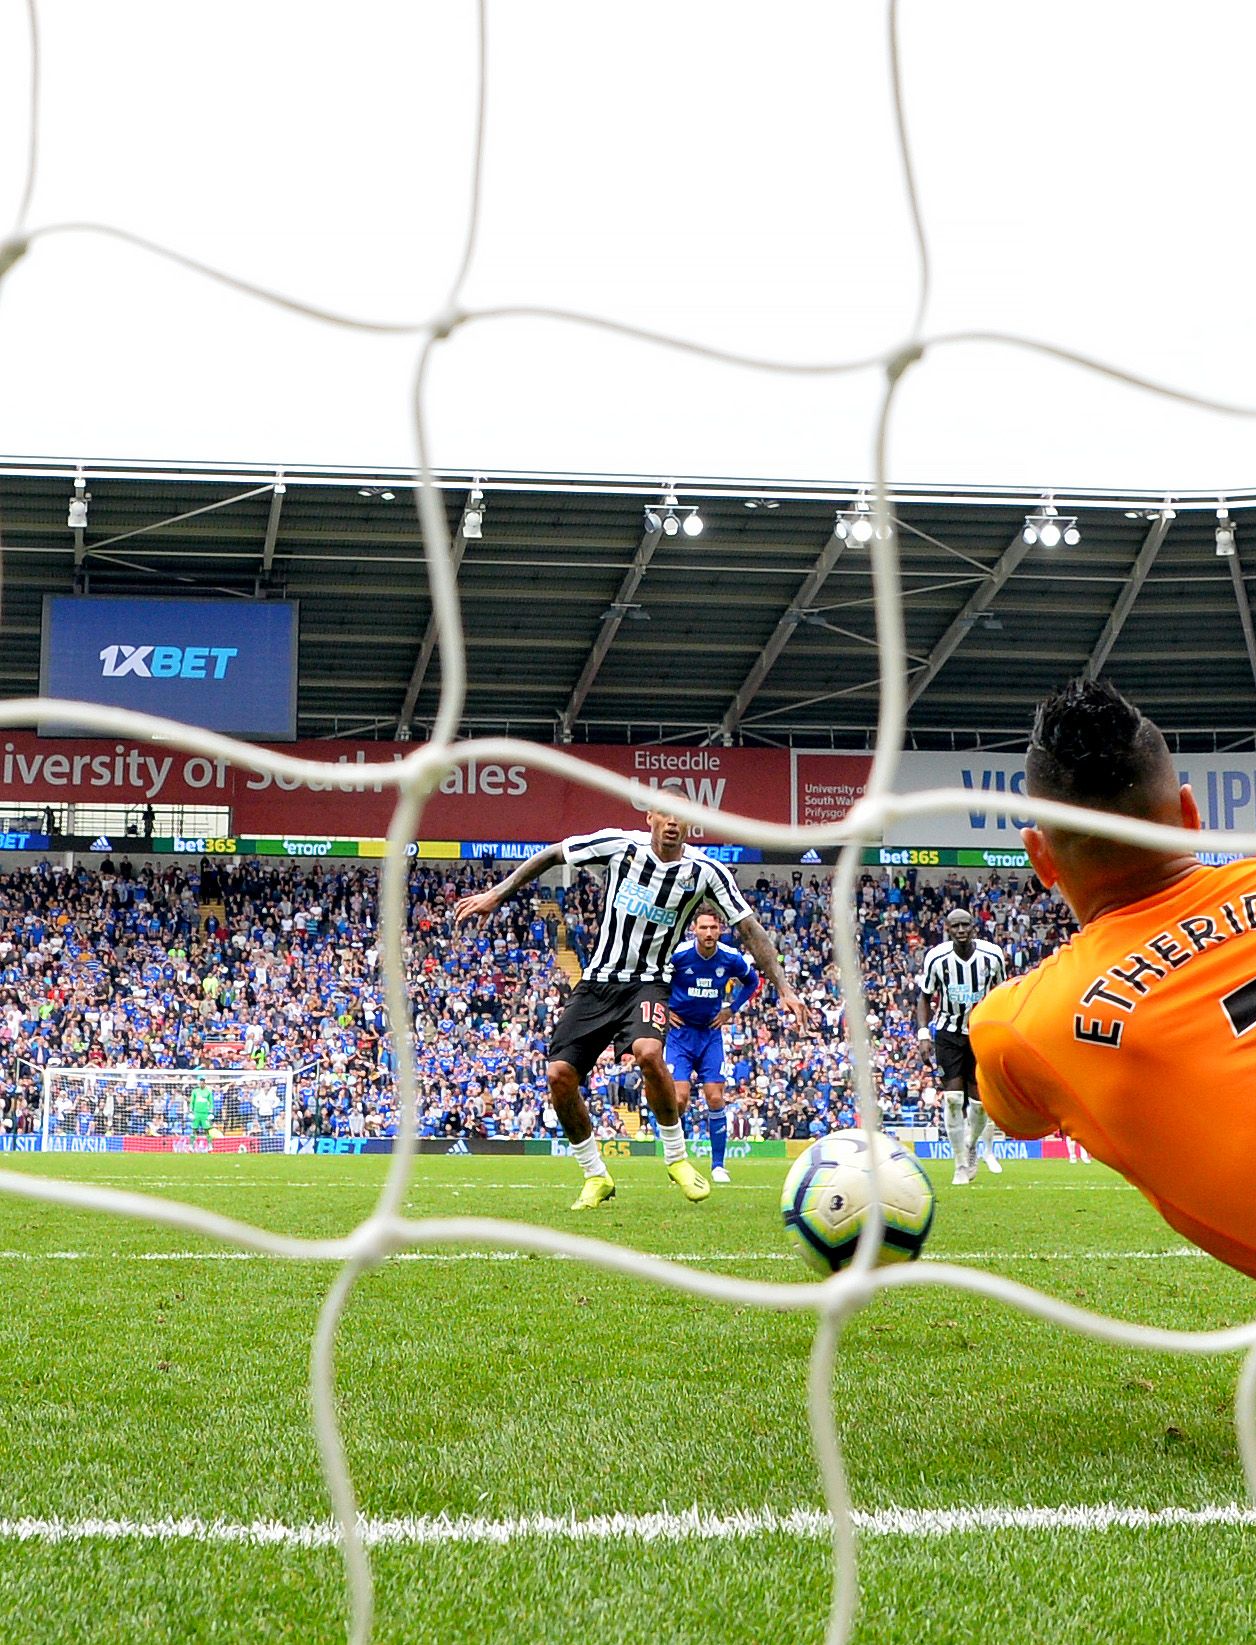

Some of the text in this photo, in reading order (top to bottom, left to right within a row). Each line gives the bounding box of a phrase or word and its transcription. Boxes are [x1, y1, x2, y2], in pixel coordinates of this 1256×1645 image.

[100, 645, 238, 679] 1XBET
[634, 751, 720, 771] Eisteddle
[630, 776, 727, 812] UW
[805, 784, 854, 795] University
[805, 796, 855, 806] South Wal
[805, 807, 846, 820] Prifysgol
[173, 837, 237, 852] bet365
[880, 849, 939, 865] bet365
[640, 1001, 667, 1025] 15
[2, 1136, 37, 1152] VSIT
